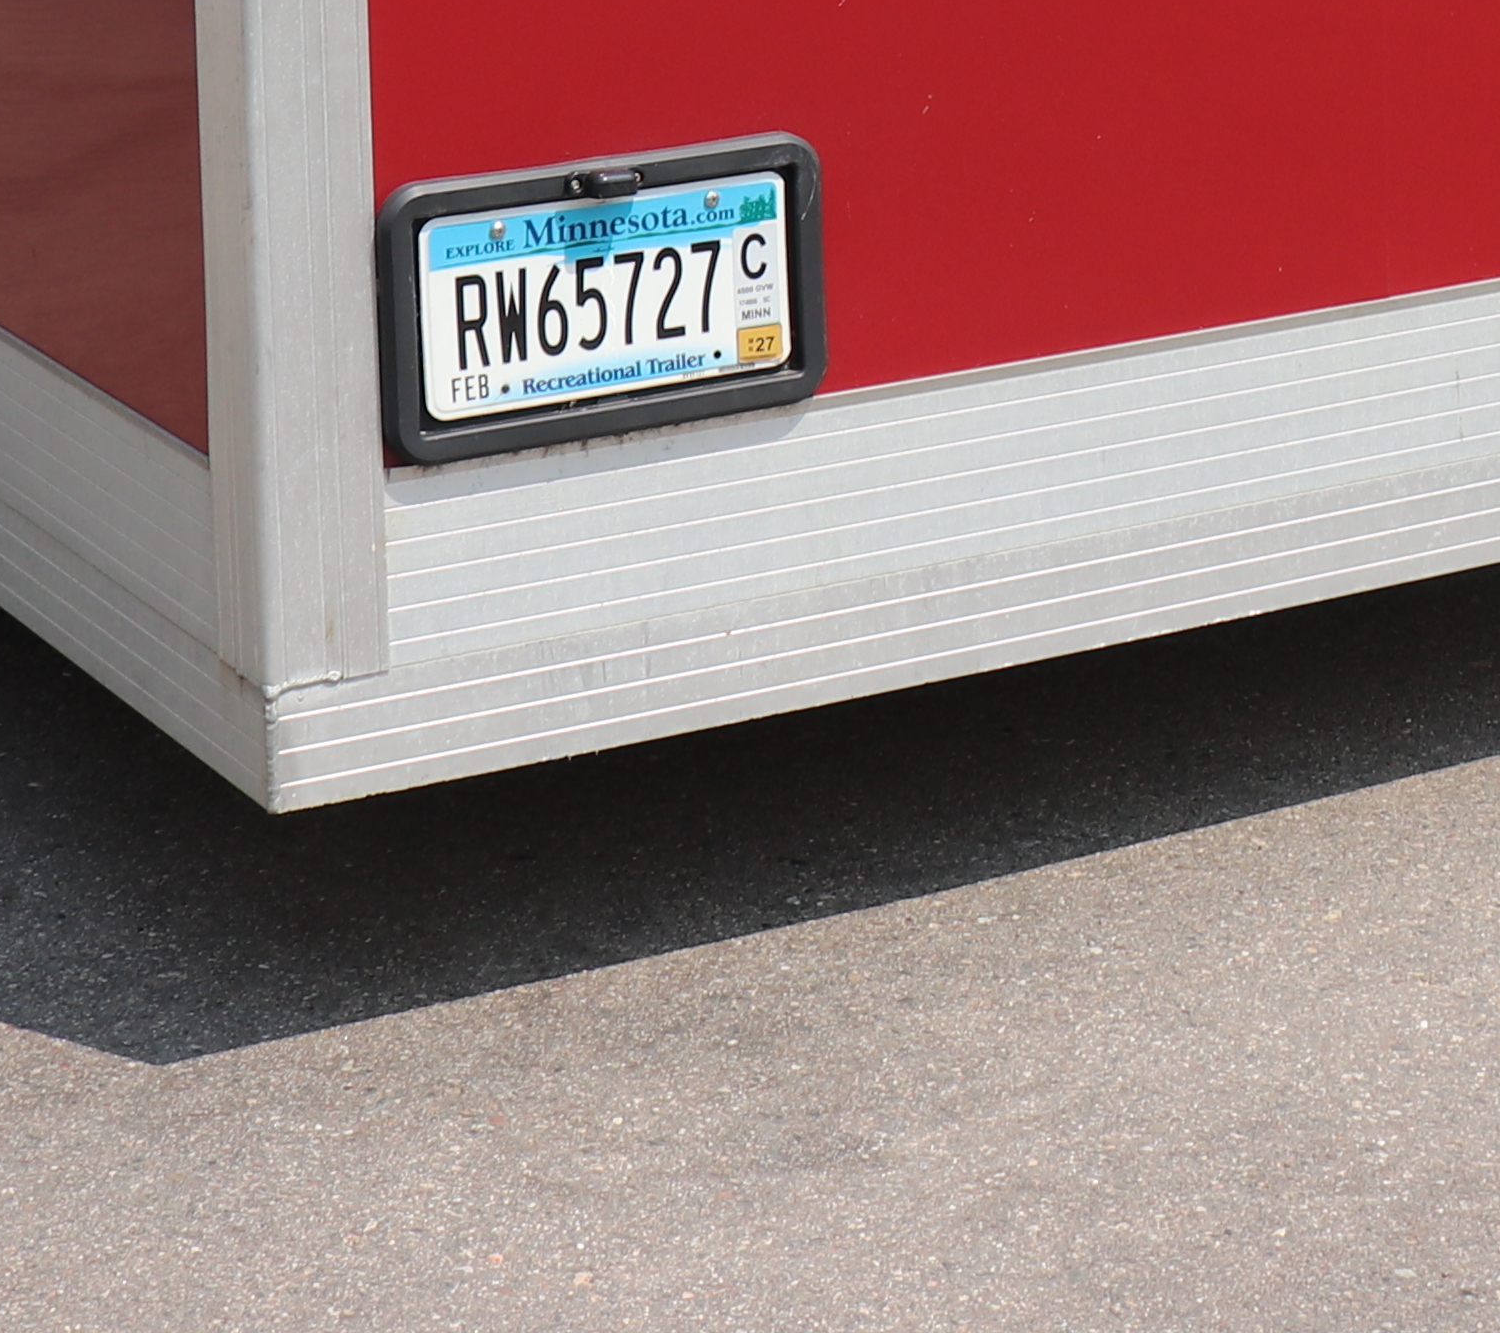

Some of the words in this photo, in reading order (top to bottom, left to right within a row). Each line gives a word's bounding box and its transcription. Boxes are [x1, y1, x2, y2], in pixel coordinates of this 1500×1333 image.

[445, 239, 516, 260] EXPLORE
[522, 203, 736, 249] Minnesota.com
[740, 233, 767, 280] C
[454, 239, 721, 371] RW65727
[741, 306, 771, 321] MINN
[755, 336, 775, 352] 27
[451, 373, 490, 404] FEB
[522, 364, 642, 396] Recreational
[644, 353, 707, 376] Trailer
